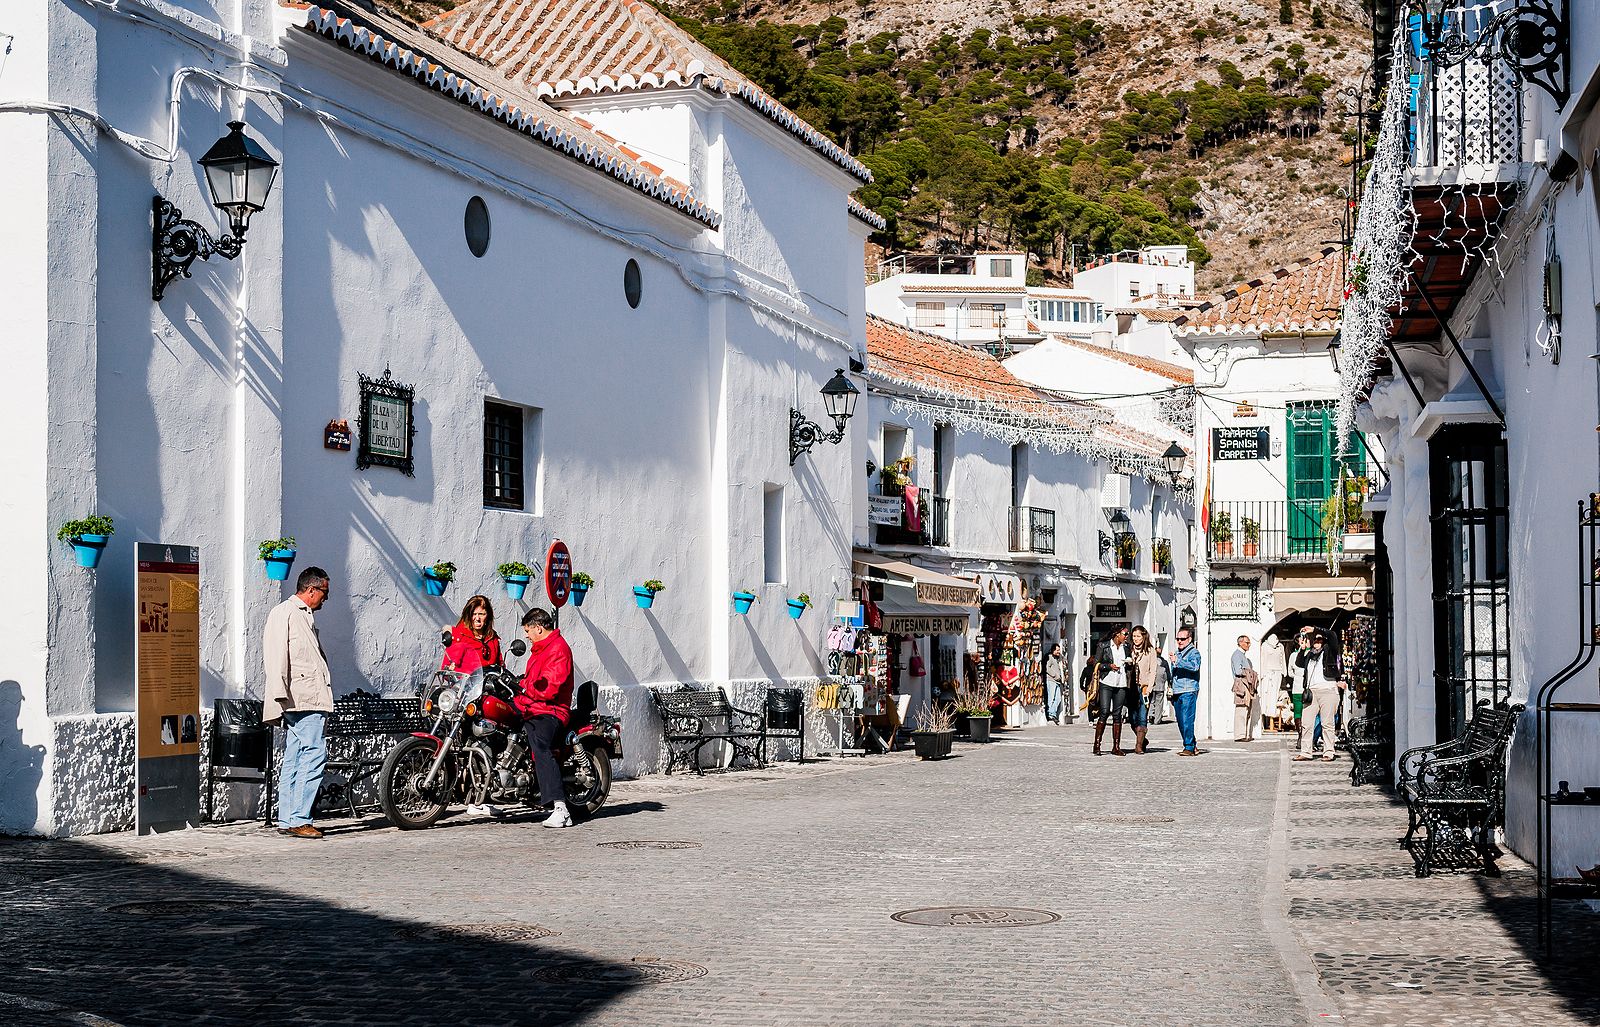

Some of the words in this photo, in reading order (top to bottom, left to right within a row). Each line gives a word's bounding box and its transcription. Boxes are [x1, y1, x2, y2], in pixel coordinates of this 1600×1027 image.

[372, 404, 390, 417] PLAZA
[372, 419, 380, 429] DE
[381, 420, 389, 431] LA
[371, 433, 401, 449] LIBERTAD
[1219, 439, 1258, 449] SPANISH
[1219, 450, 1258, 459] CARPETS
[917, 584, 937, 600] BAZAR
[937, 586, 949, 602] SAN
[890, 618, 930, 632] ARTESANIA
[932, 618, 942, 632] ER
[944, 618, 963, 632] CANO
